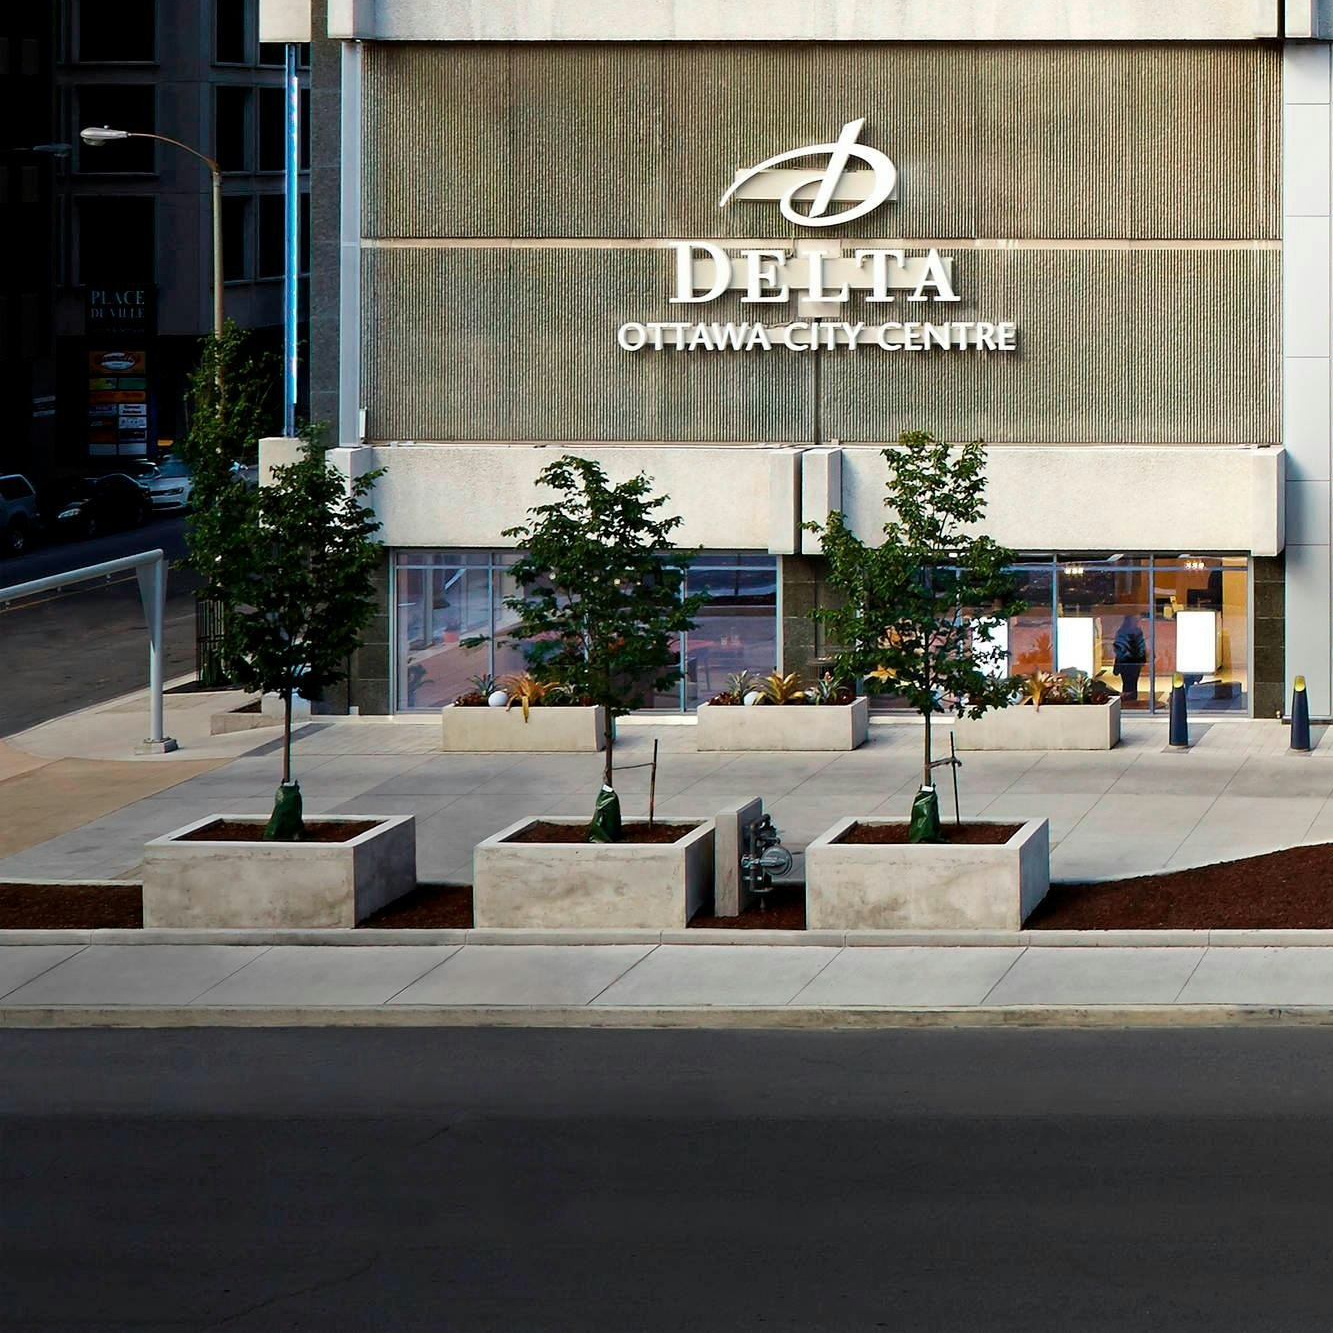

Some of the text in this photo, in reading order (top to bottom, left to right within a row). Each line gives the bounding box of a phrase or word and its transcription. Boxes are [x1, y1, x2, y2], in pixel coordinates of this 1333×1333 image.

[668, 241, 961, 303] DELTA
[90, 289, 145, 306] PLACE
[617, 321, 1017, 351] OTTAWA CITY CENTRE
